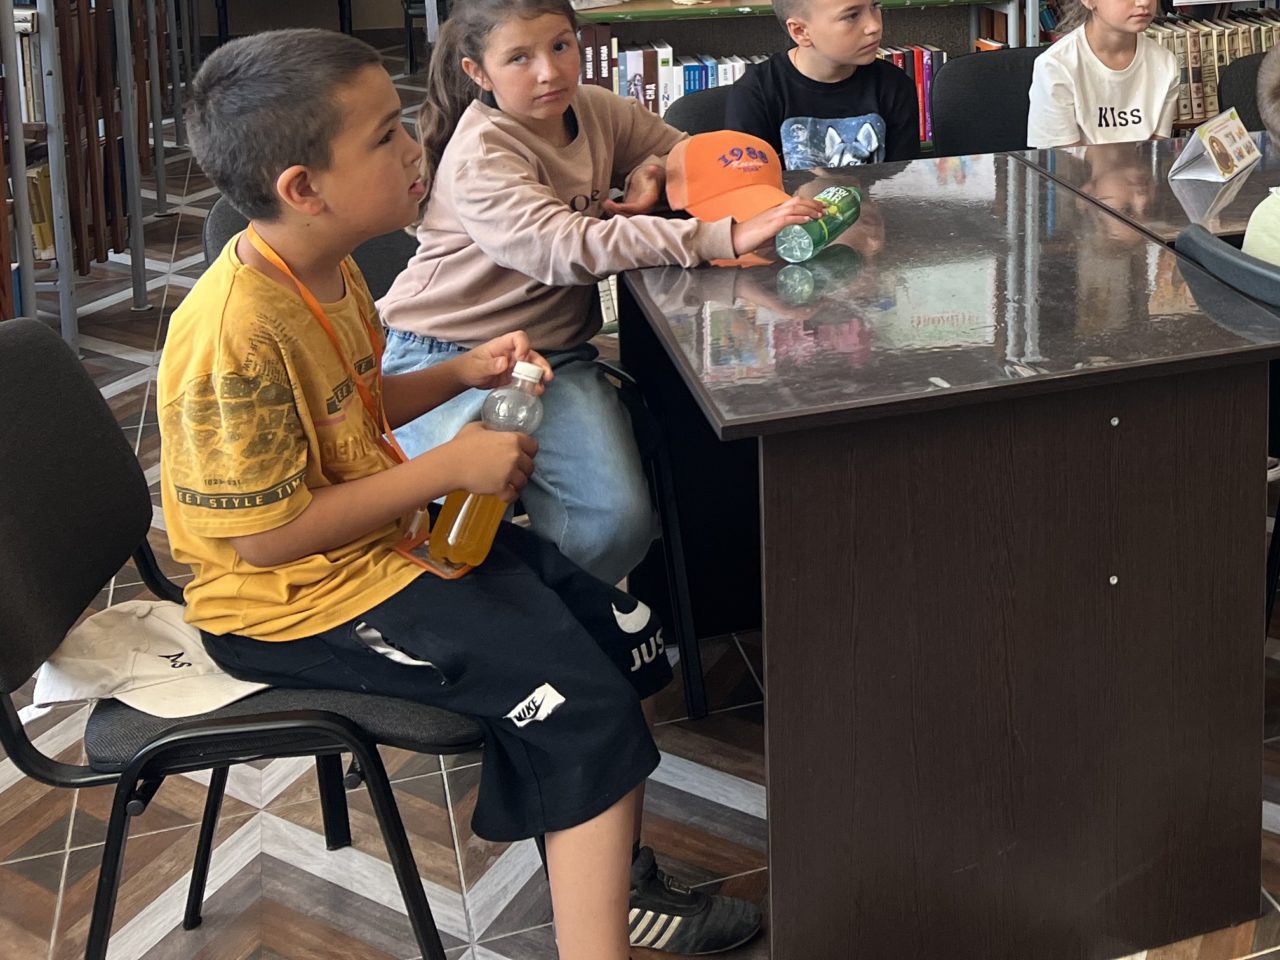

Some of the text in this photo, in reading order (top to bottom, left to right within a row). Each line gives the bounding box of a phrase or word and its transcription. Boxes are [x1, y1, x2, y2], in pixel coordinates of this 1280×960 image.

[209, 496, 264, 508] STYLE
[277, 475, 306, 499] TIM
[630, 626, 667, 673] JUS
[513, 695, 539, 722] NIKE
